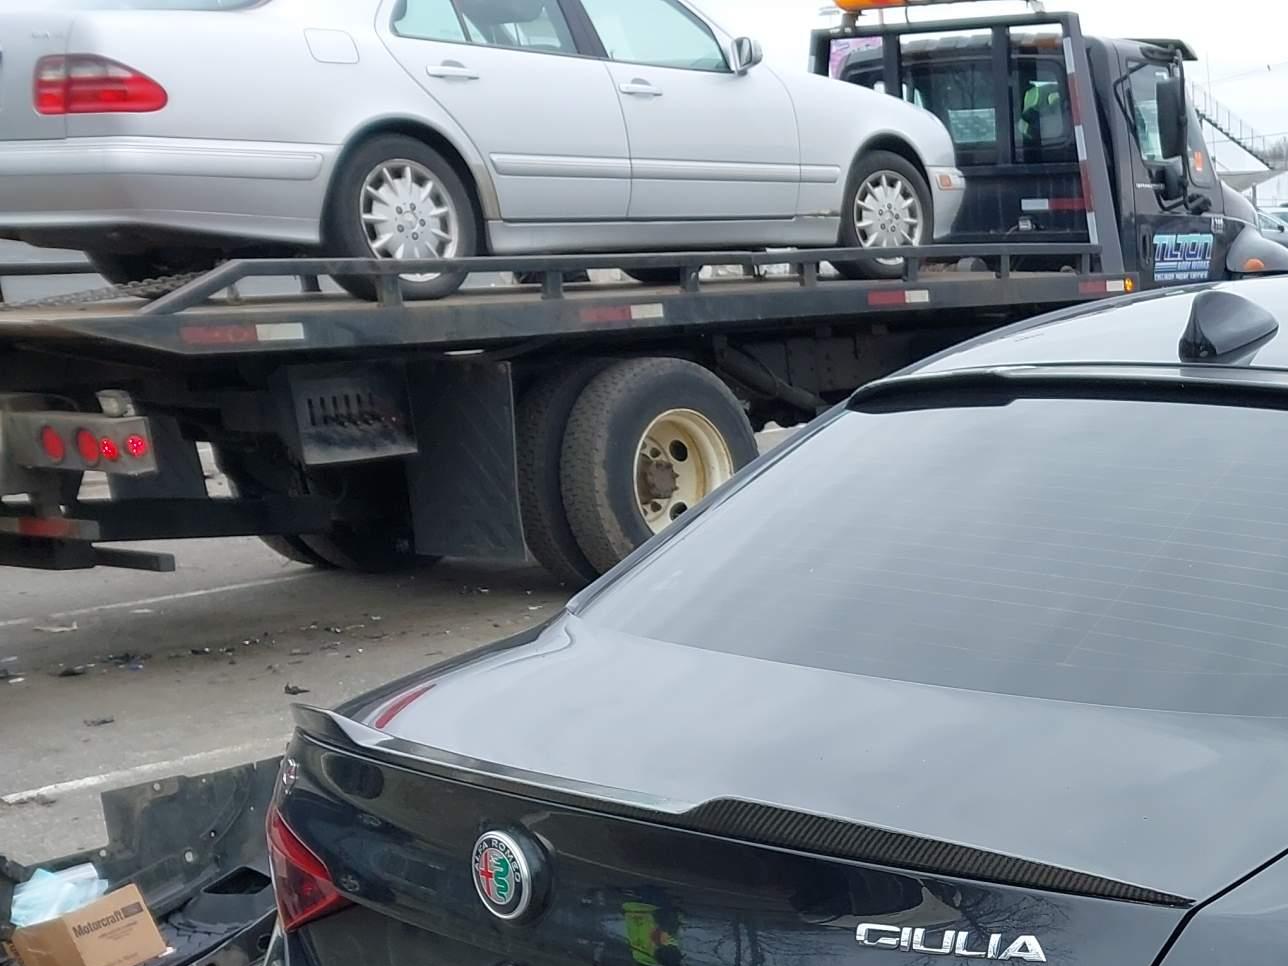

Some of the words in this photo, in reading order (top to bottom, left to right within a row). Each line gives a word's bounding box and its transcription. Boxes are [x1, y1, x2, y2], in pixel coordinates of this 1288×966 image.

[1153, 233, 1214, 261] TILTON
[474, 841, 488, 872] ALFA
[491, 839, 522, 883] ROMEO
[72, 910, 125, 938] Motorcraft
[855, 922, 1047, 963] GIULIA
